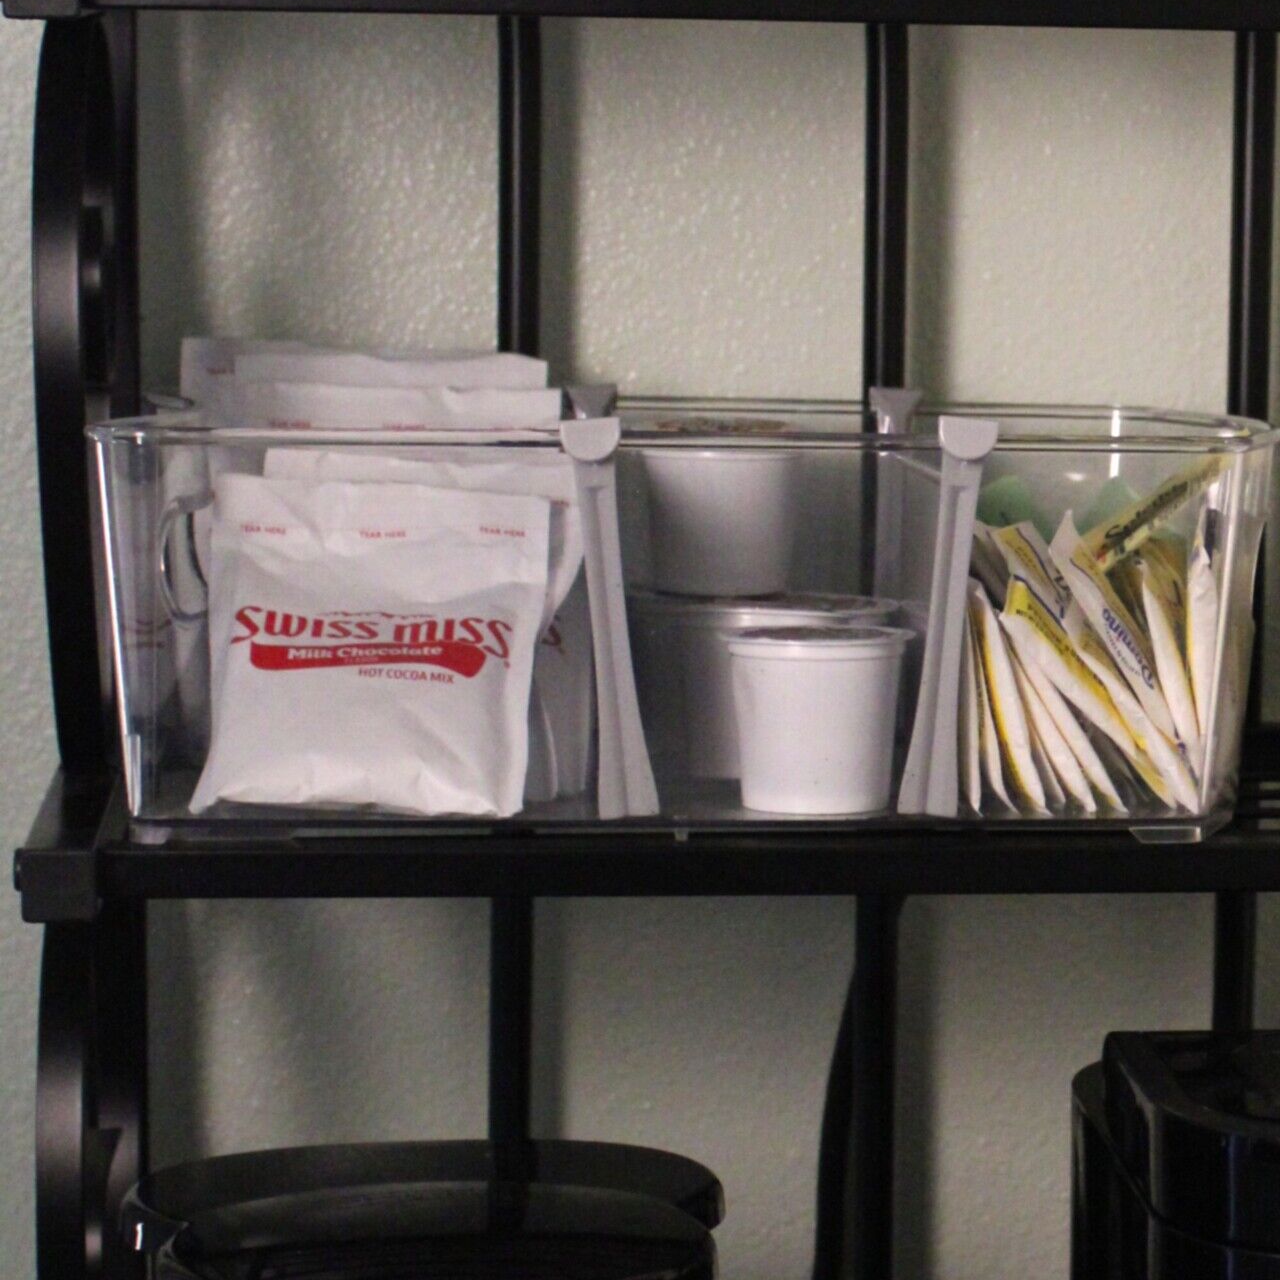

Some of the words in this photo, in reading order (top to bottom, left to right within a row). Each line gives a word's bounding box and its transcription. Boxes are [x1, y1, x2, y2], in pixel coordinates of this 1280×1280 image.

[286, 646, 334, 660] Milk
[336, 643, 444, 658] Chocolate
[1101, 607, 1155, 691] Domino
[358, 667, 385, 679] HOT
[386, 669, 428, 682] COCOA
[430, 672, 455, 684] MIX
